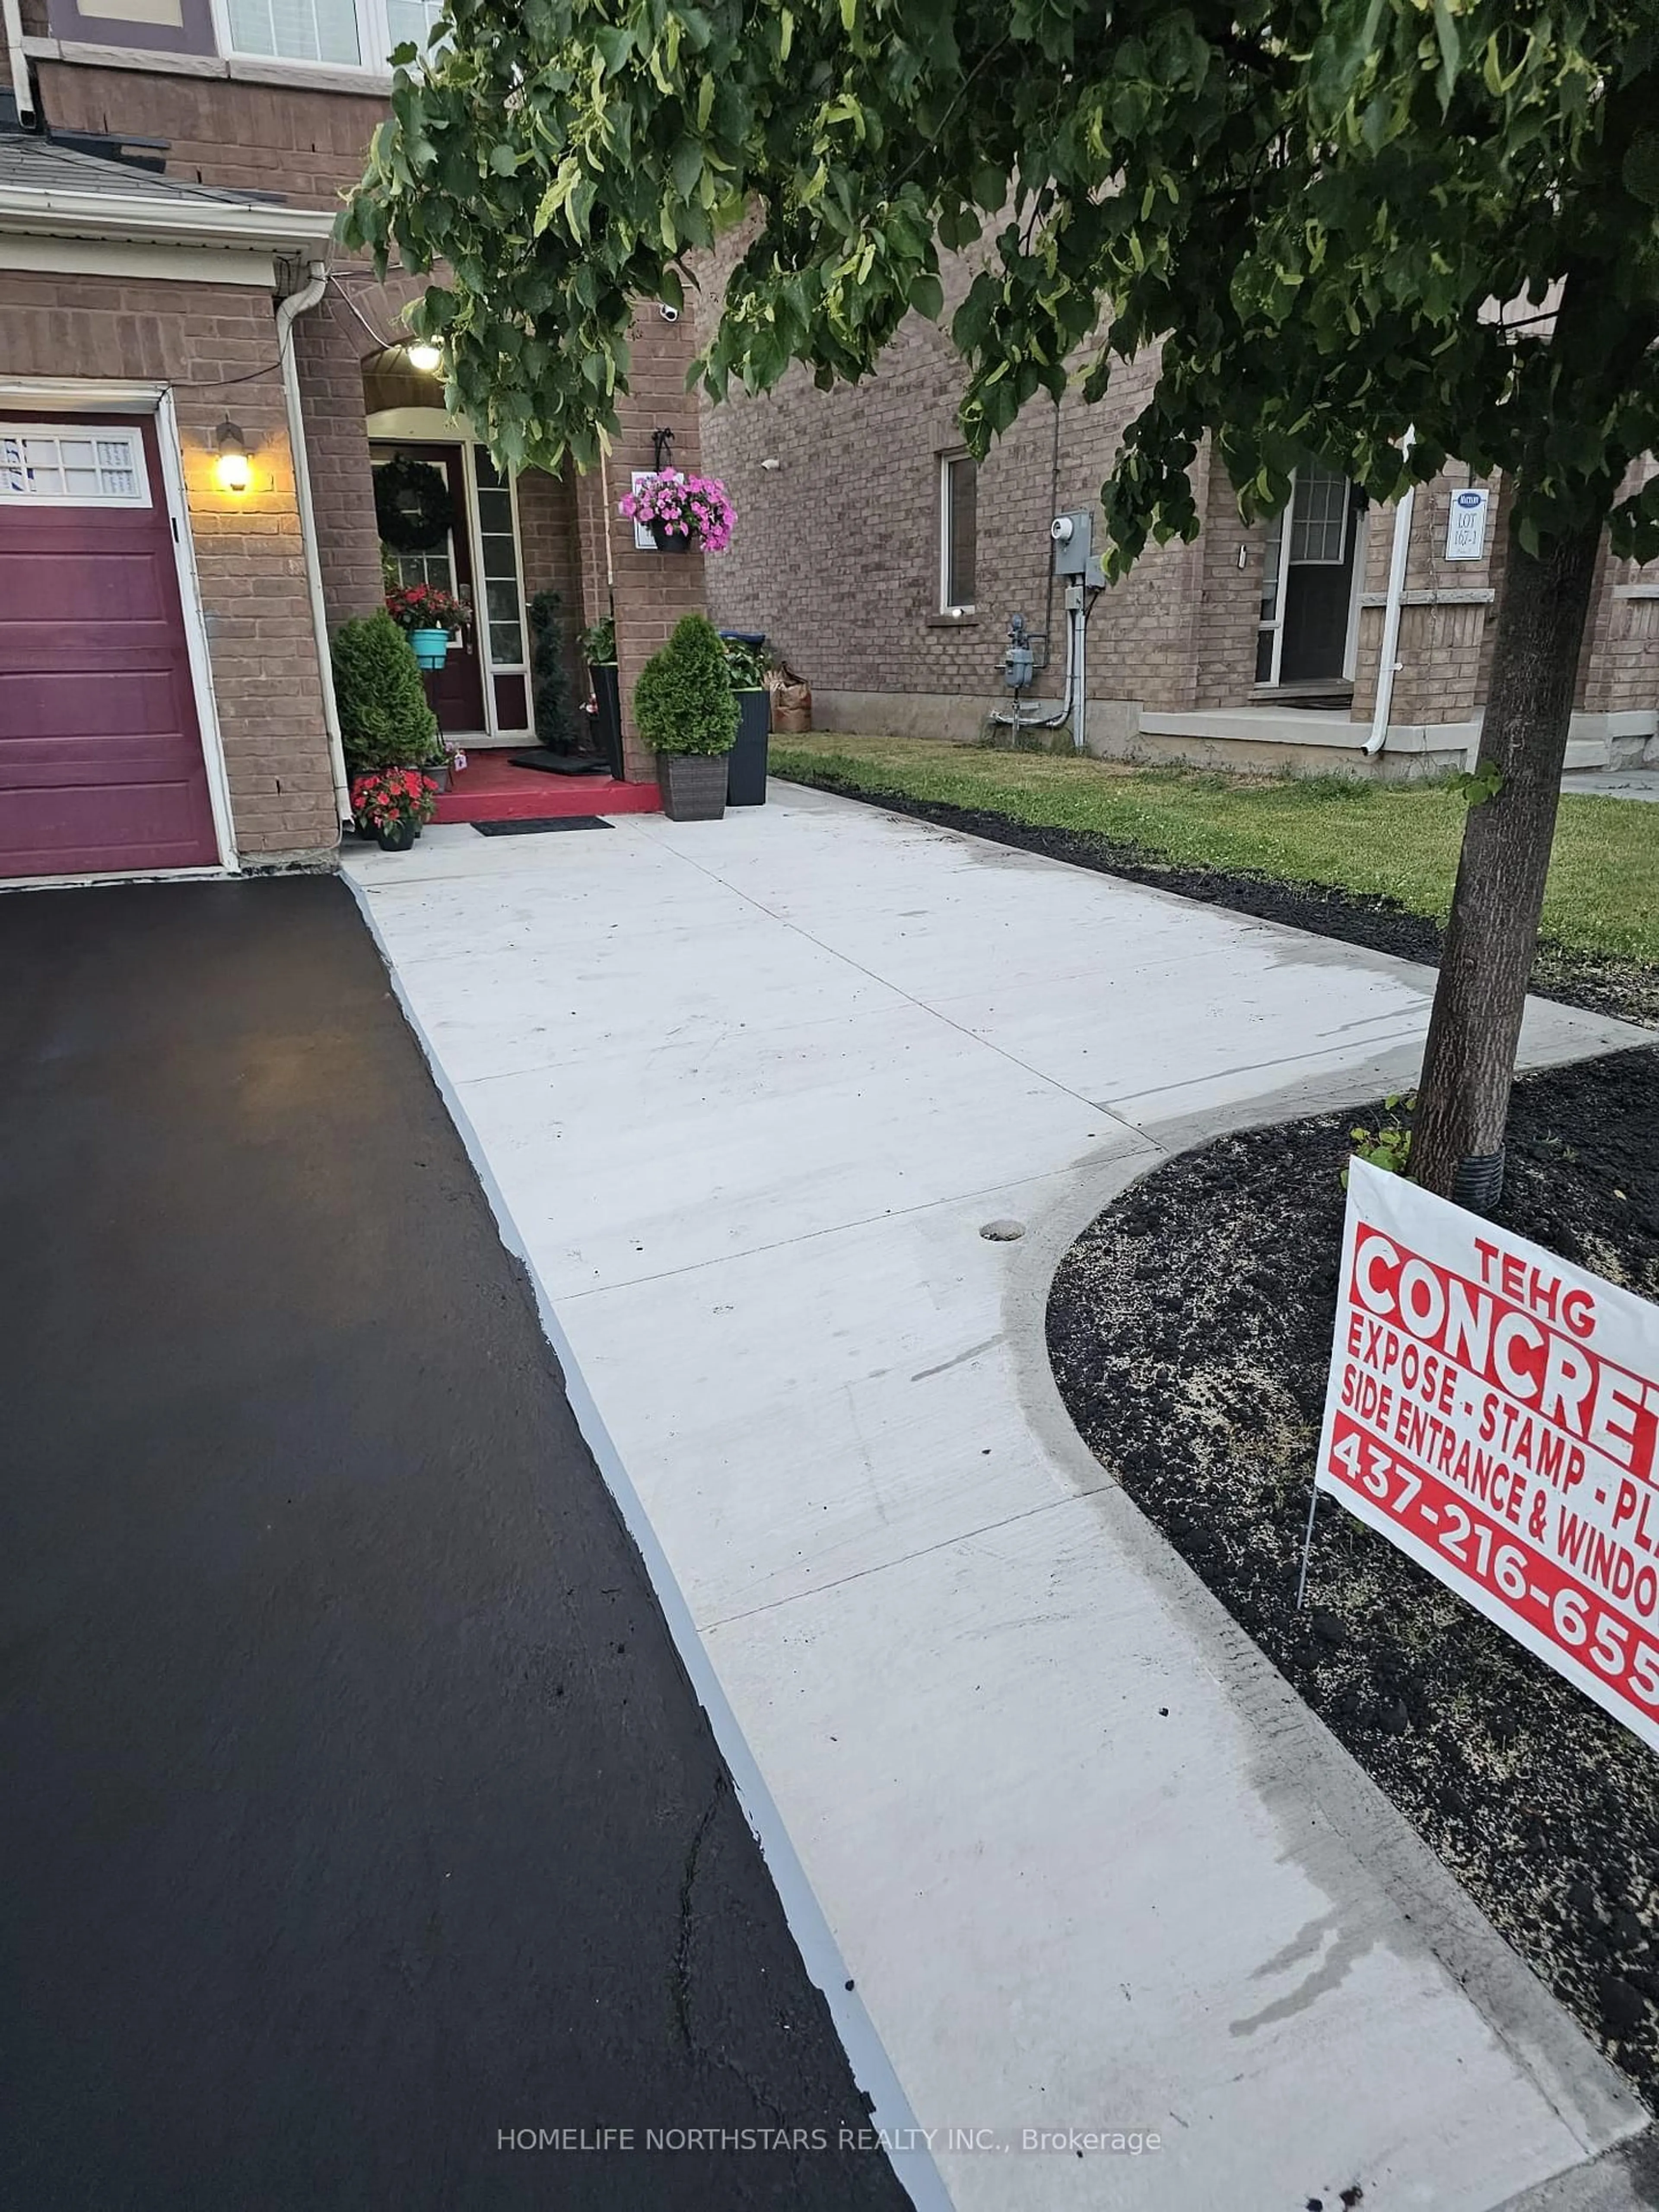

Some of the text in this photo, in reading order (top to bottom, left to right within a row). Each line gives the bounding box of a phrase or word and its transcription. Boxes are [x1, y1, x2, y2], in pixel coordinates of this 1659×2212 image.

[1458, 513, 1477, 528] LOT
[1474, 1236, 1596, 1338] TEHG
[1341, 1363, 1392, 1433] SIDE
[1394, 1395, 1527, 1525] ENTRANCE
[1529, 1489, 1547, 1545] &
[1348, 1311, 1457, 1415] EXPOSE
[1479, 1394, 1585, 1495] STAMP
[1611, 1477, 1659, 1558] PL
